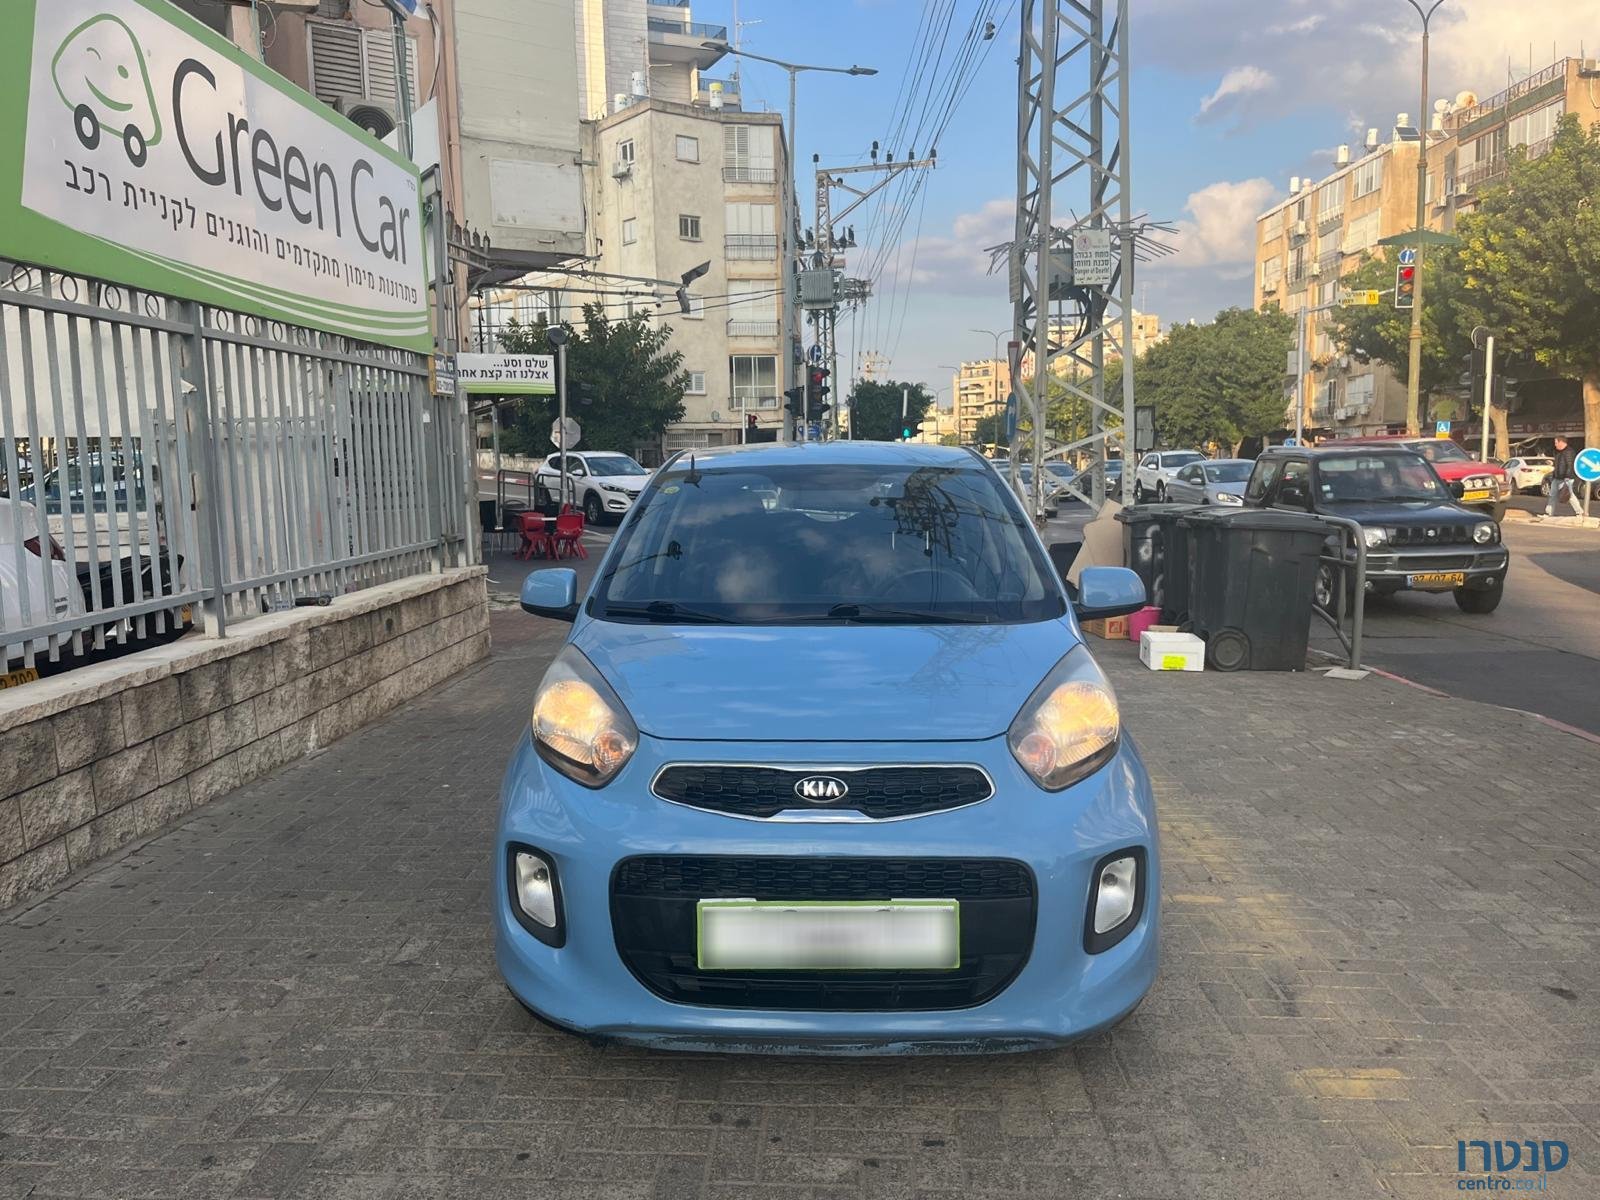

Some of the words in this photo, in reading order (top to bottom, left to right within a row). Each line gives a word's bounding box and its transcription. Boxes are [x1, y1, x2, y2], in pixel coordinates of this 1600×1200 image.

[172, 58, 341, 238] Green
[351, 158, 409, 265] Car
[64, 159, 111, 201] רכב
[123, 181, 196, 231] לקניית
[206, 212, 269, 255] והוגנים
[276, 238, 340, 277] מתקדמים
[344, 263, 375, 290] מימון
[378, 275, 418, 304] פתרונות
[457, 369, 477, 378] אחר
[480, 369, 502, 381] קצת
[505, 369, 517, 379] זה
[520, 368, 549, 379] אצלנו
[525, 358, 548, 368] שלם
[803, 780, 840, 797] KIA
